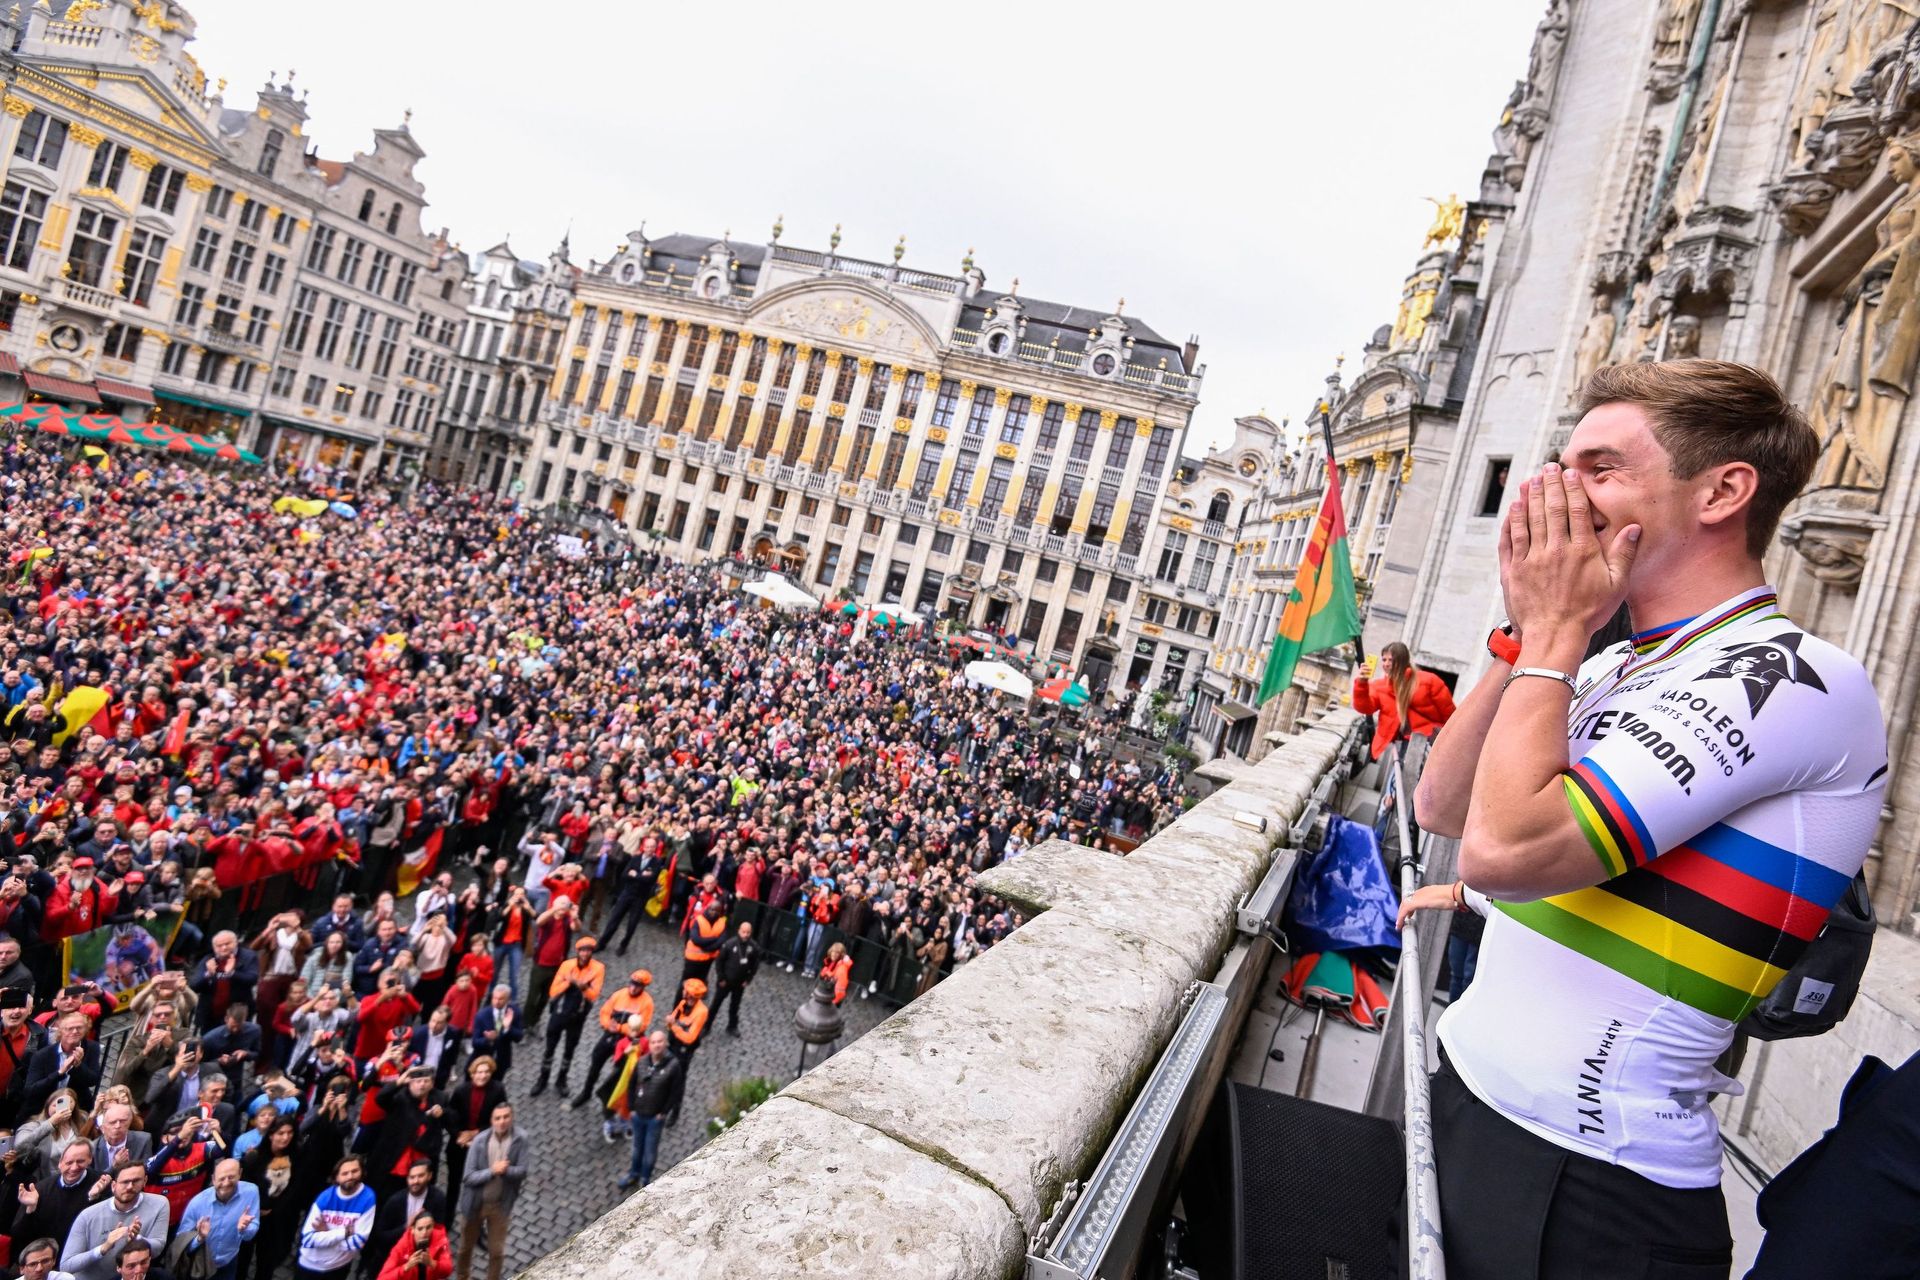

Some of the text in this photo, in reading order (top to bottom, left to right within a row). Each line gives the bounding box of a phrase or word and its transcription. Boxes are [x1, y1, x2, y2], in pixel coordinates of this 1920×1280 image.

[1650, 704, 1734, 777] PORTS & CASINO
[1659, 689, 1756, 767] NAPOLEON
[1654, 1111, 1674, 1120] THE
